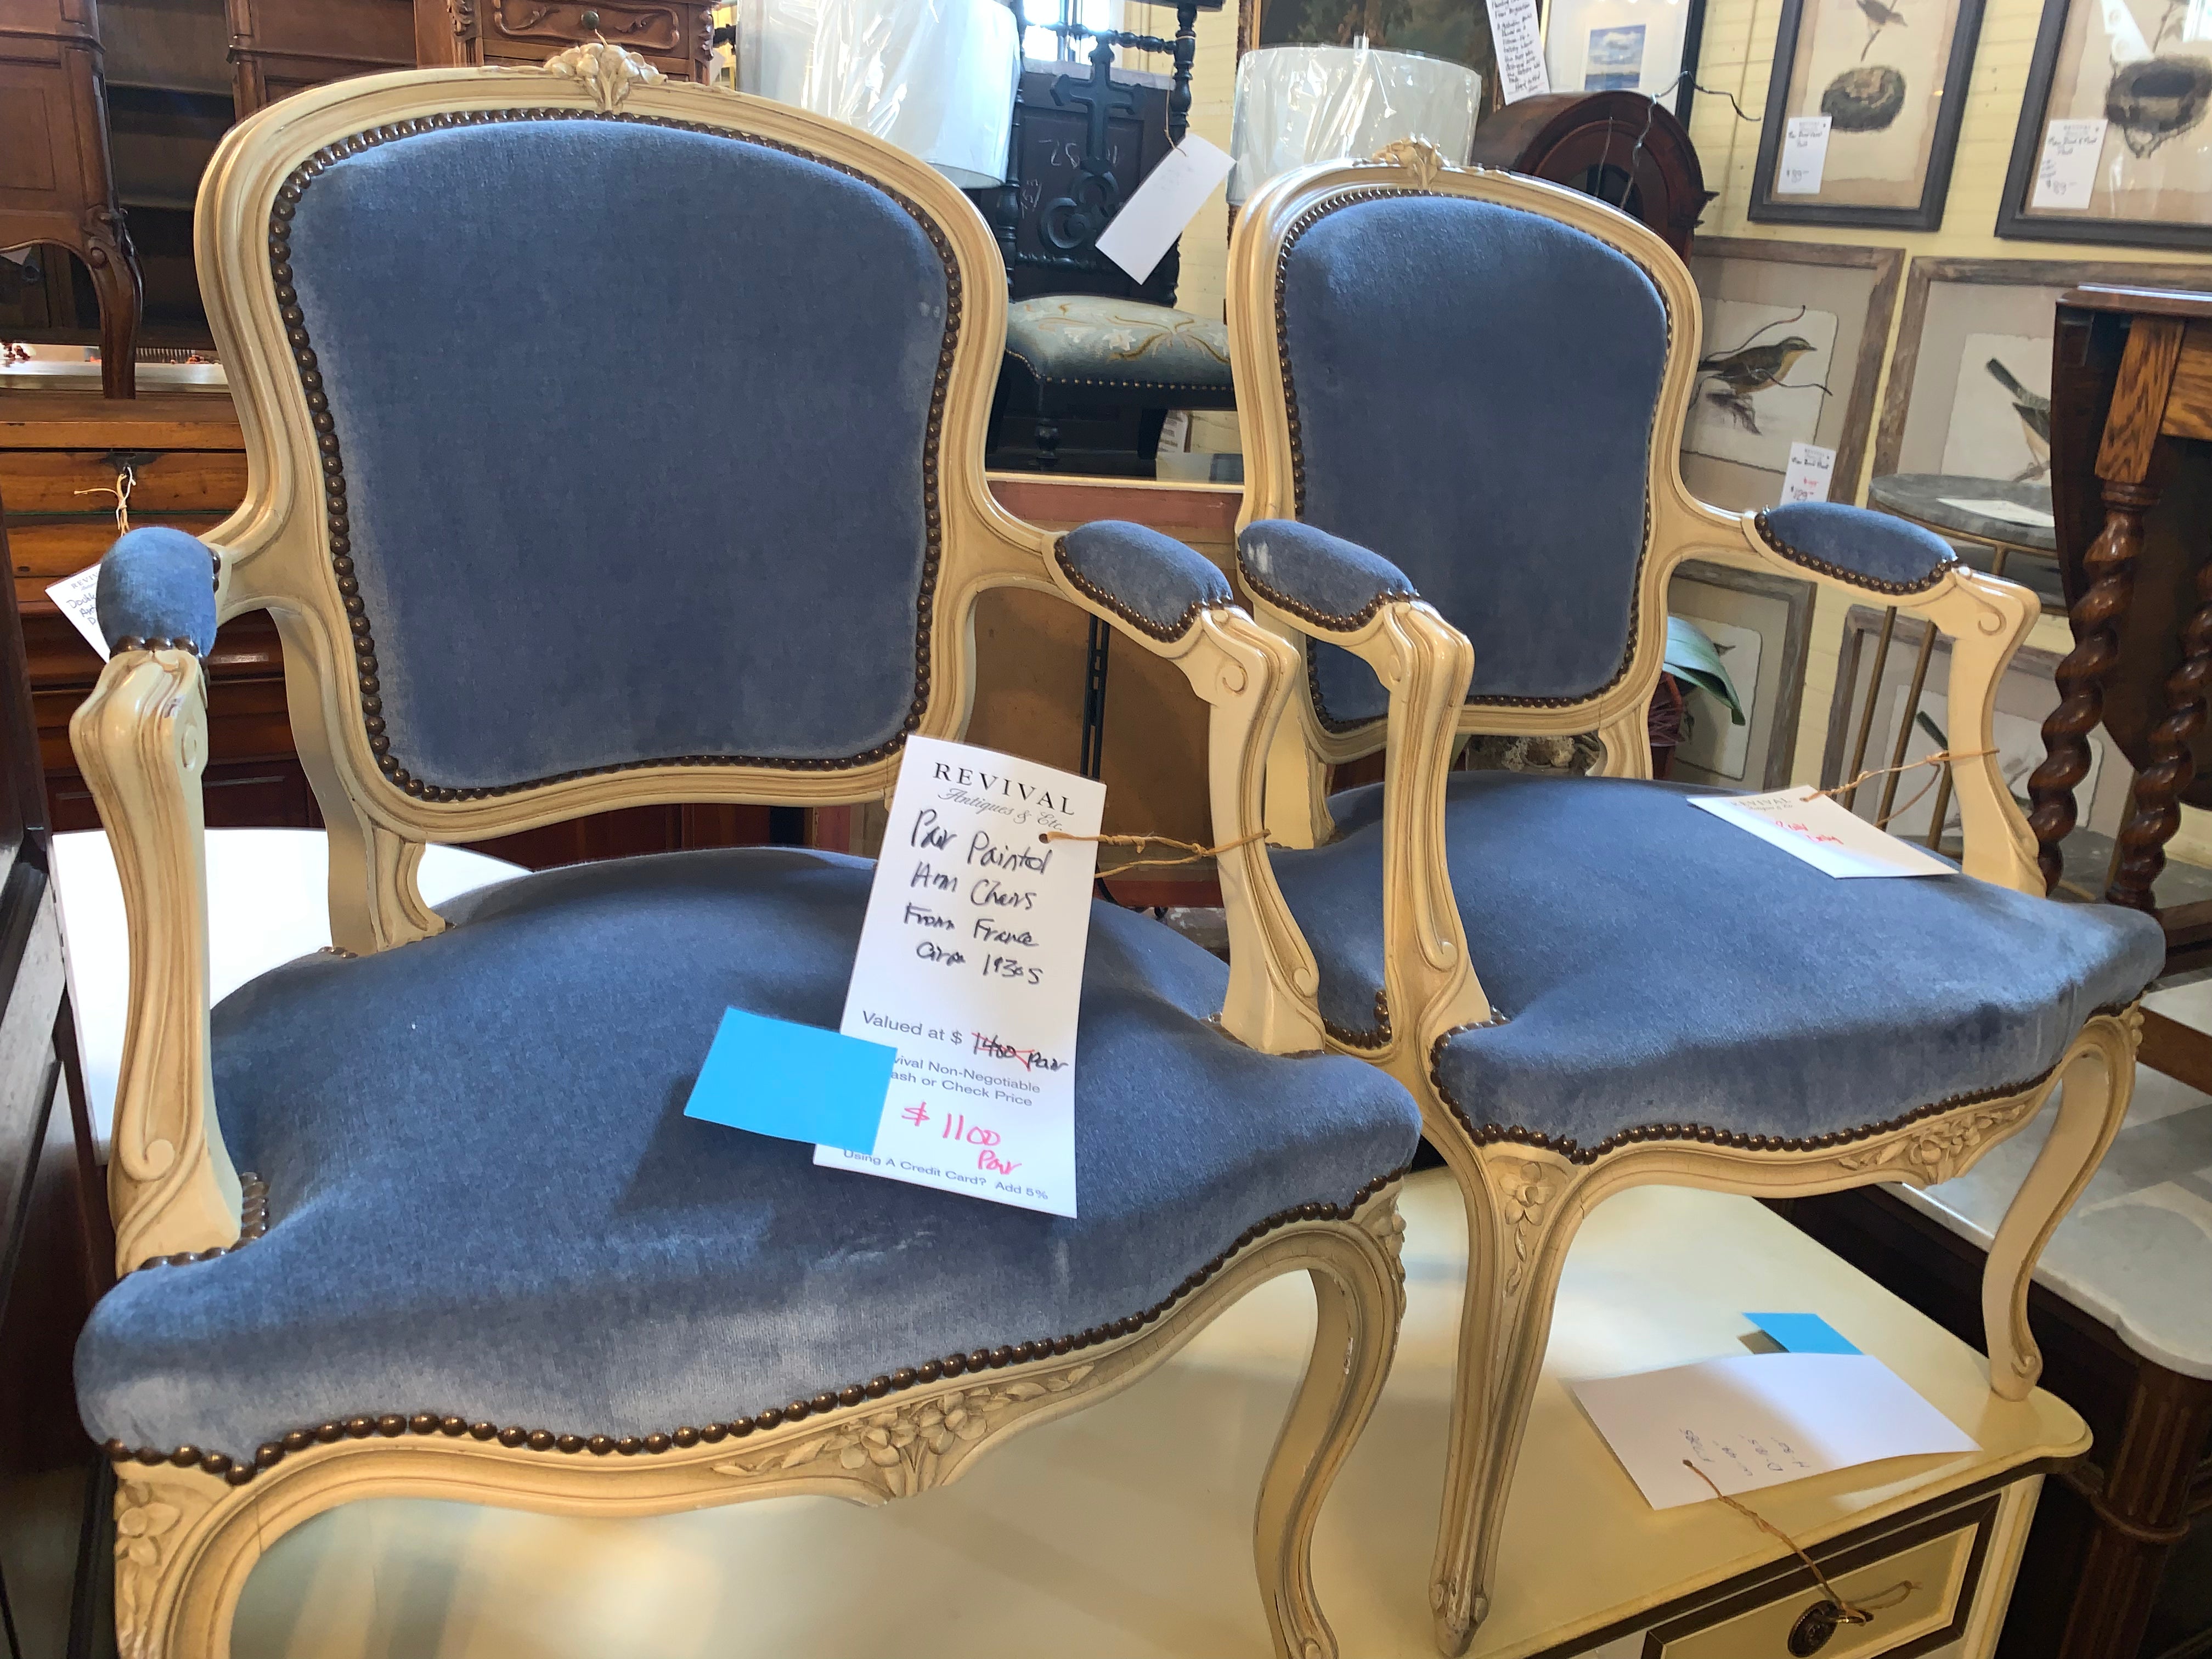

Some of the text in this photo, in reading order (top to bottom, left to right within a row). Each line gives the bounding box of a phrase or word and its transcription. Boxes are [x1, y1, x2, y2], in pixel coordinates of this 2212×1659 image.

[71, 572, 99, 589] REVIV
[933, 761, 1075, 815] REVIVAL
[938, 788, 1063, 831] Antiques & Etc.
[904, 901, 1040, 947] From France
[862, 1010, 923, 1036] Valued
[928, 1028, 945, 1042] at
[891, 1069, 1033, 1107] ash or Check Price
[894, 1054, 1042, 1093] vival Non-Negotiable
[843, 1149, 1049, 1201] Using A Credit Card? Add 5%
